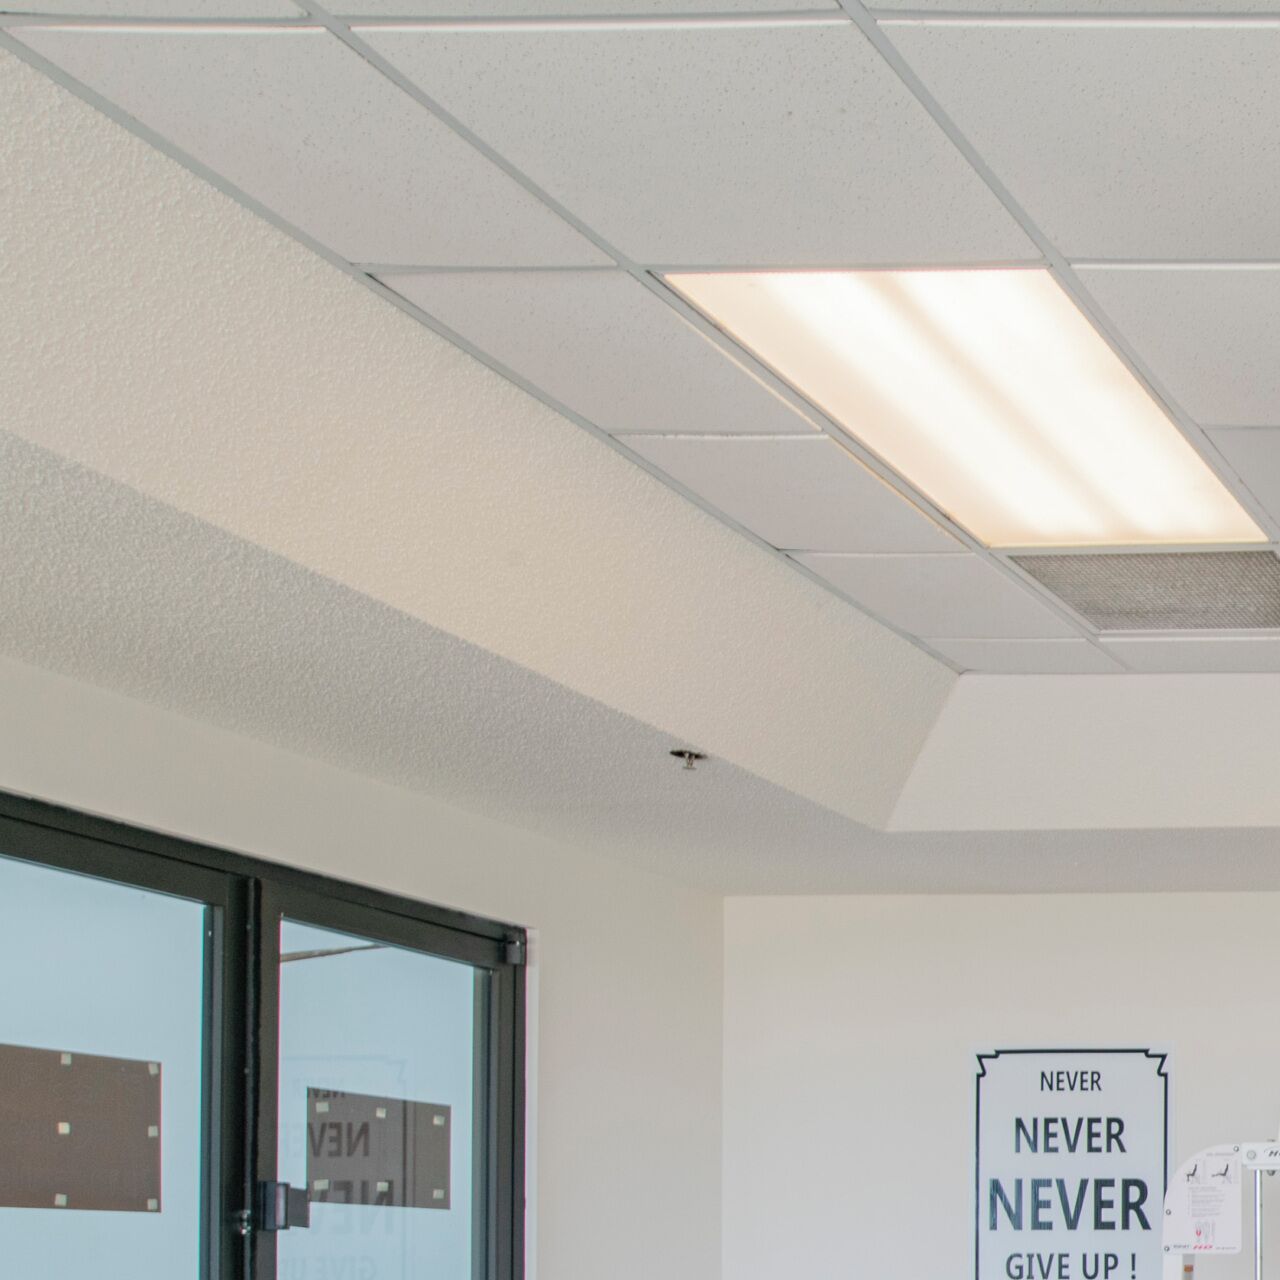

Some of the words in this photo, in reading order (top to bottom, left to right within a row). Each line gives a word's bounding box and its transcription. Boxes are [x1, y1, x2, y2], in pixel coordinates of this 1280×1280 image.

[1041, 1071, 1101, 1091] NEVER
[1015, 1117, 1126, 1153] NEVER
[988, 1177, 1152, 1231] NEVER
[1006, 1253, 1070, 1280] GIVE
[1083, 1253, 1118, 1280] UP
[1131, 1253, 1136, 1280] !
